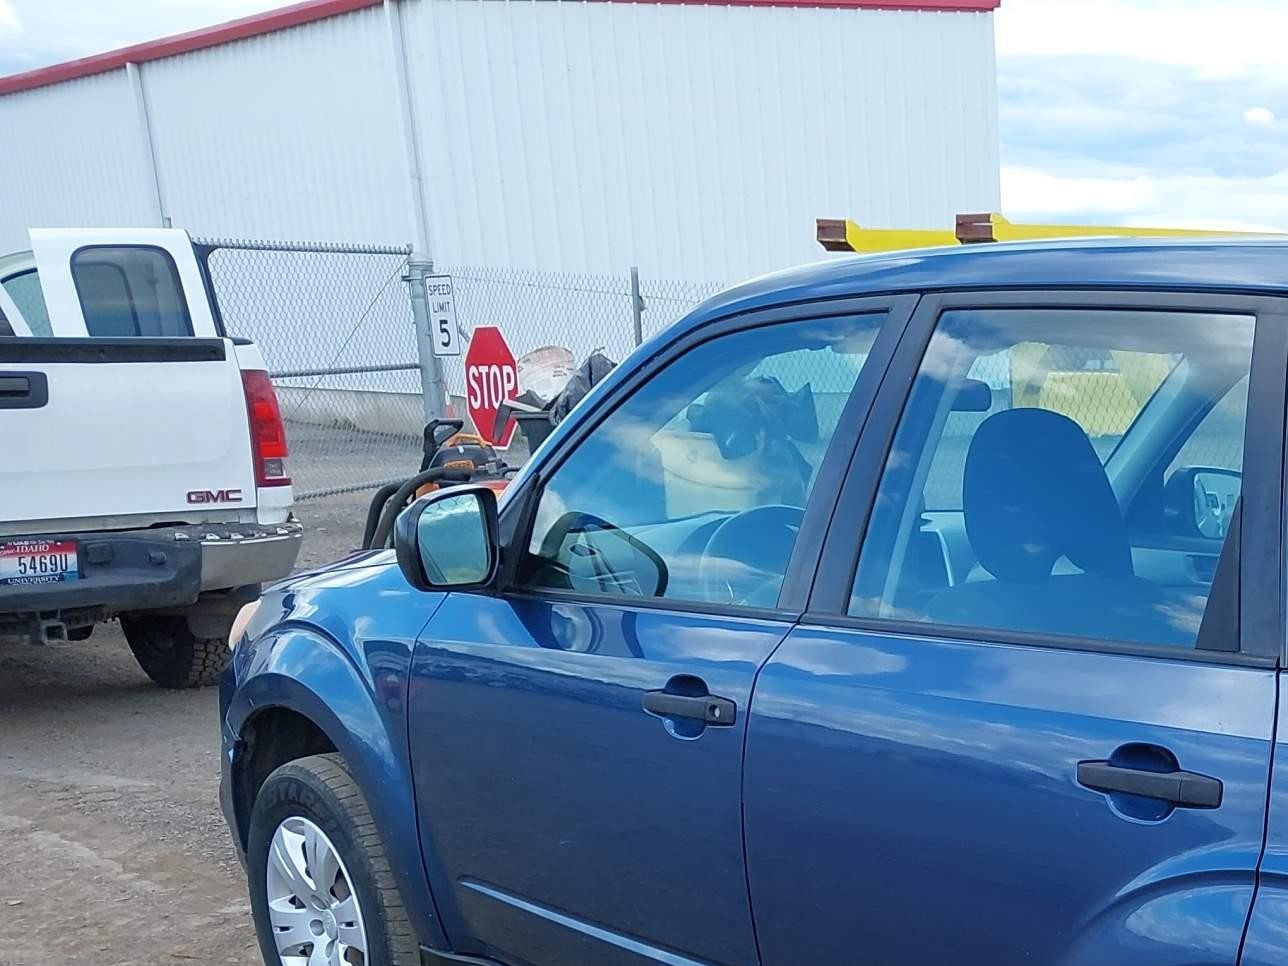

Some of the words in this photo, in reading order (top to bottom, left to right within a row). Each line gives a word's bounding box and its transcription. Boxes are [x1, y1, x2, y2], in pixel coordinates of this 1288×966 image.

[428, 284, 451, 296] SPEED
[432, 301, 451, 313] LIMIT
[438, 319, 451, 347] 5
[468, 365, 515, 409] STOP
[187, 489, 242, 503] GMC
[16, 544, 50, 553] IDAHO
[18, 553, 68, 575] 5469U
[7, 575, 59, 585] UNIVERSITY
